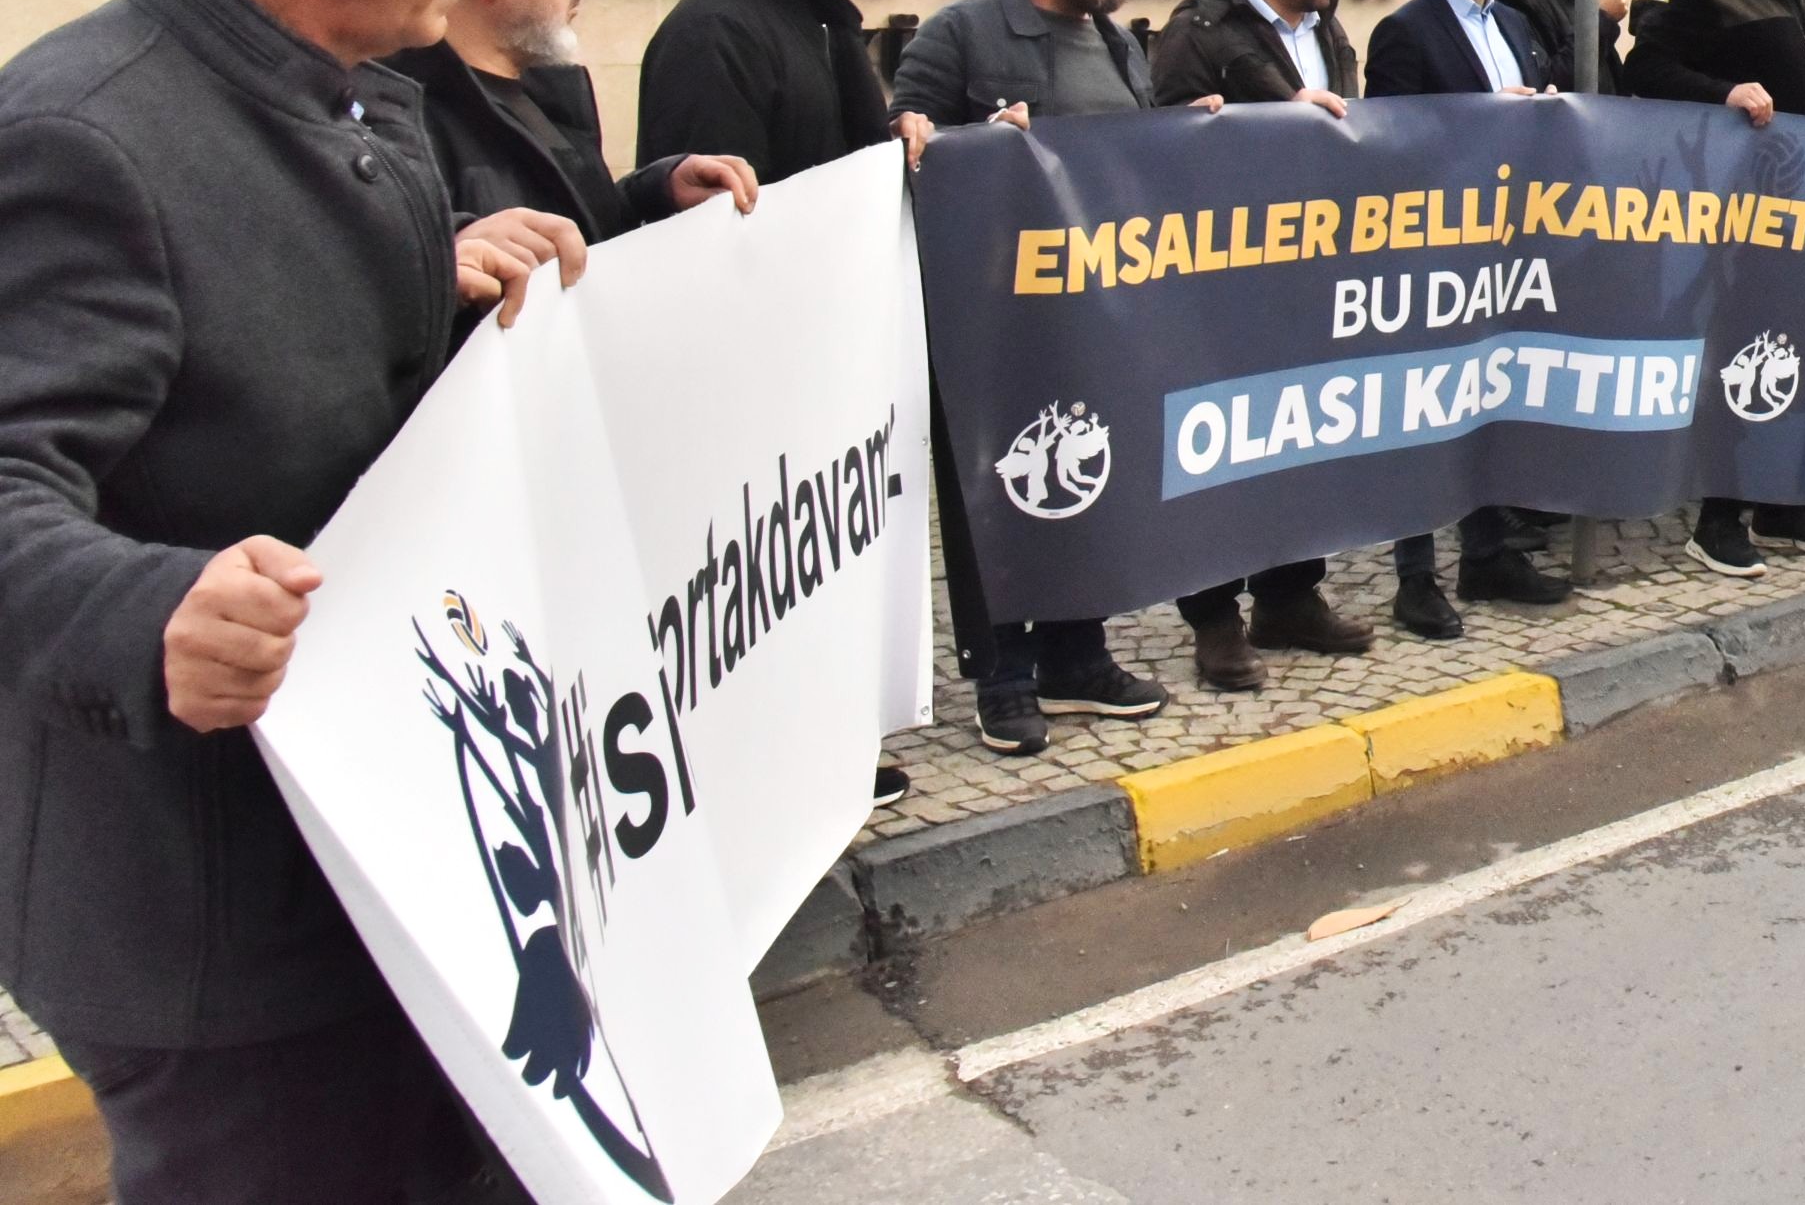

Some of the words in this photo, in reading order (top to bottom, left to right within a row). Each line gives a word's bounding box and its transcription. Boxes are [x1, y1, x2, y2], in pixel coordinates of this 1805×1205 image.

[1014, 200, 1337, 295] EMSALLER
[1350, 163, 1516, 254] BELLİ,
[1331, 272, 1413, 339] BU
[1426, 257, 1558, 331] DAVA
[1176, 381, 1382, 477] OLASI
[1402, 345, 1698, 436] KASTTIR!
